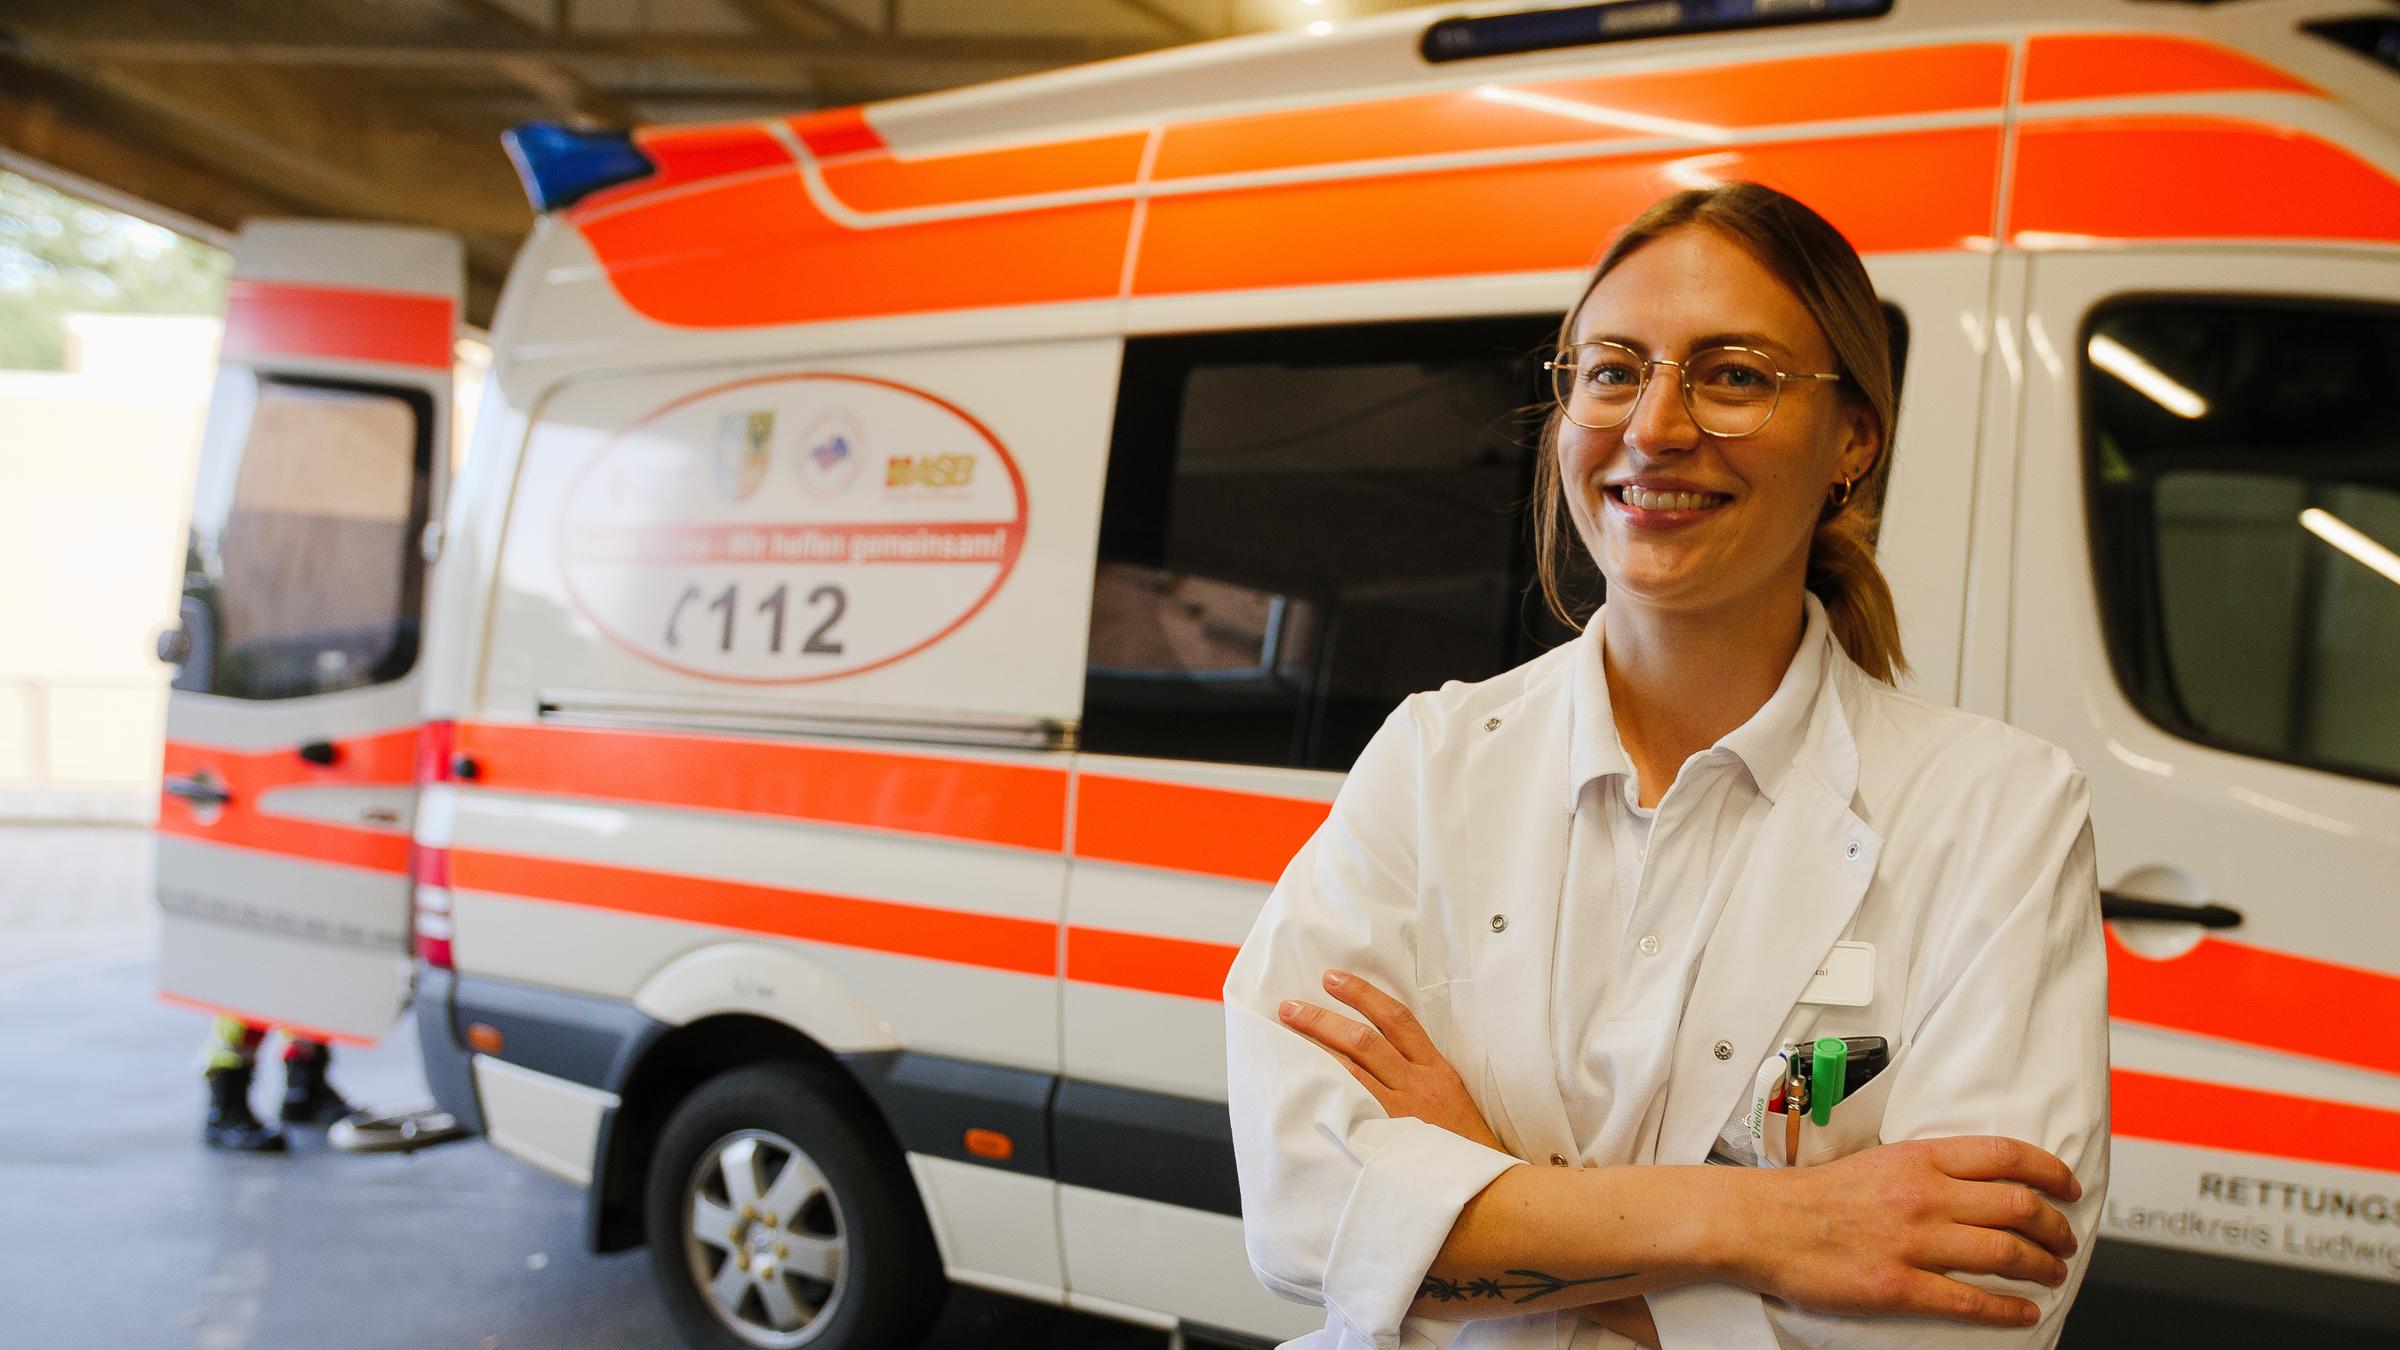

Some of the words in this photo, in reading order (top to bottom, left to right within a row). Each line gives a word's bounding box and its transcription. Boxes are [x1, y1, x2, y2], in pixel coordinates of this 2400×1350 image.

[708, 583, 848, 656] 112
[1753, 1096, 1765, 1133] Helios
[2106, 1198, 2272, 1250] Landkreis
